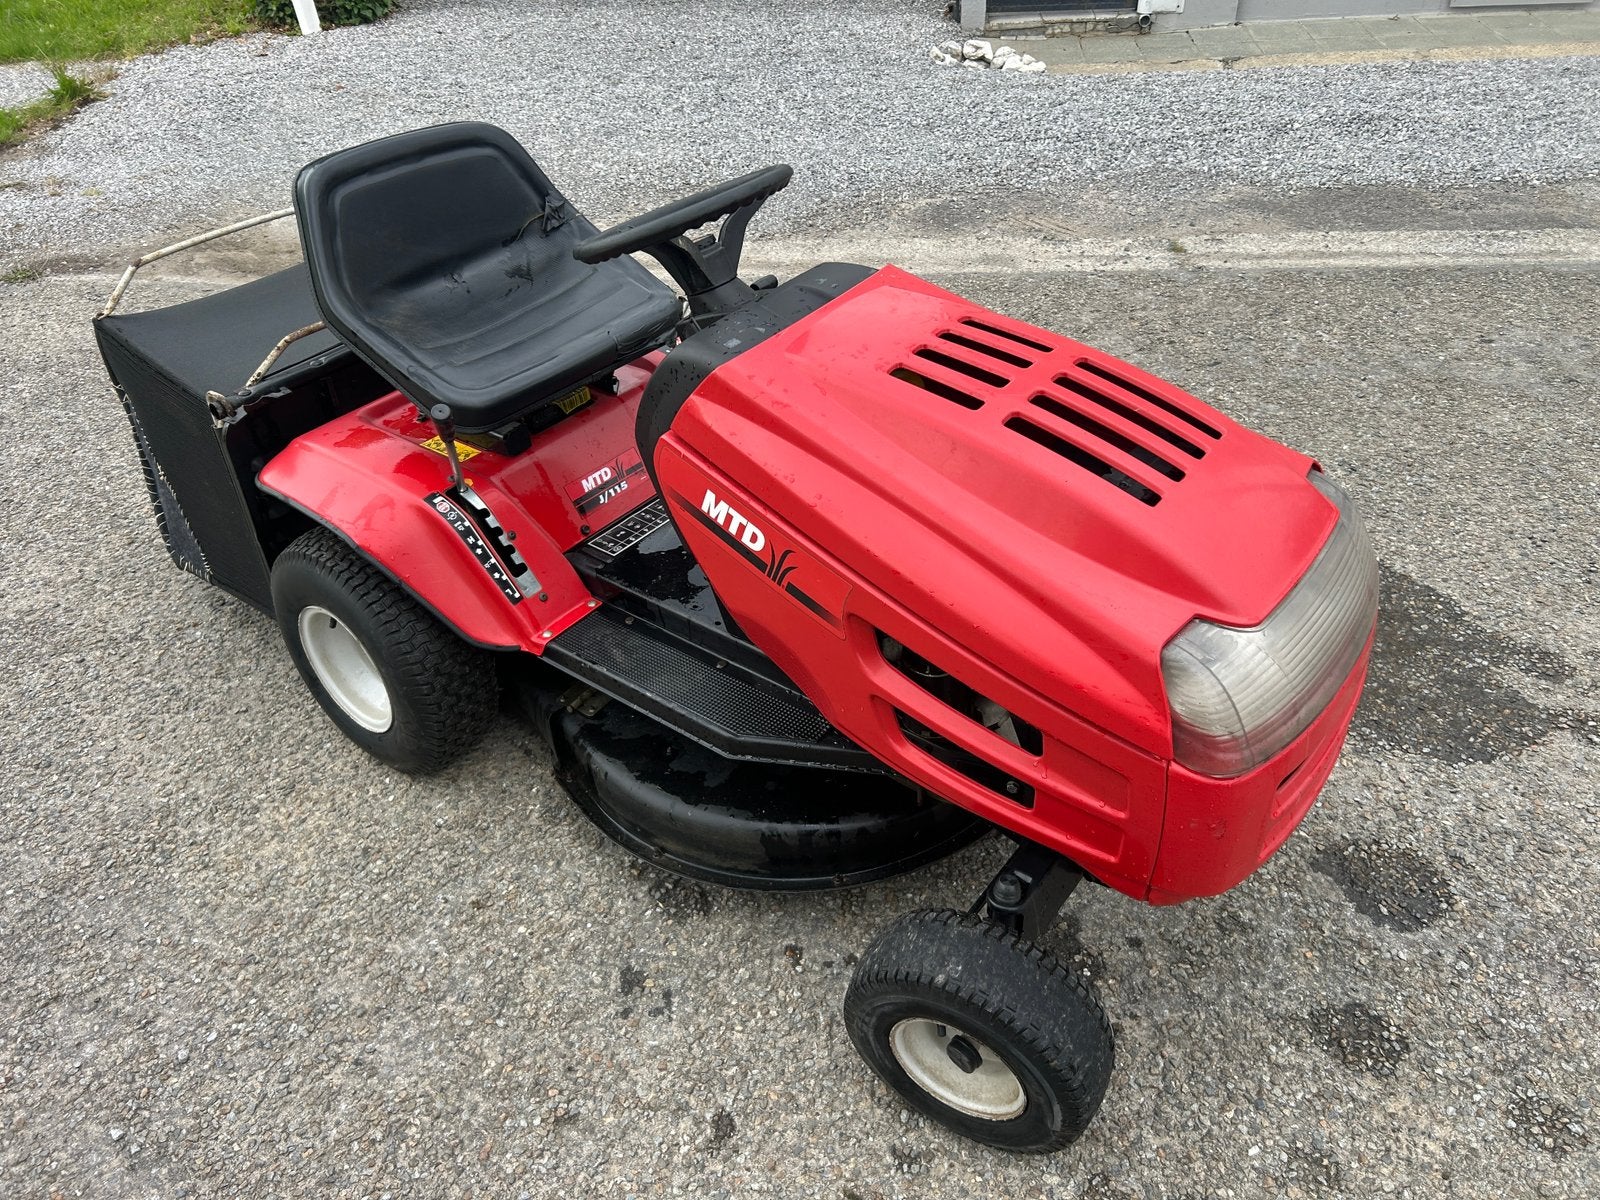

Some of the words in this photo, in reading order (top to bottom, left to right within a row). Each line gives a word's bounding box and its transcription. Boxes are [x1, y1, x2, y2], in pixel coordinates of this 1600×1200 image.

[581, 467, 611, 492] MTD
[599, 481, 628, 503] J/115
[701, 489, 766, 551] MTD
